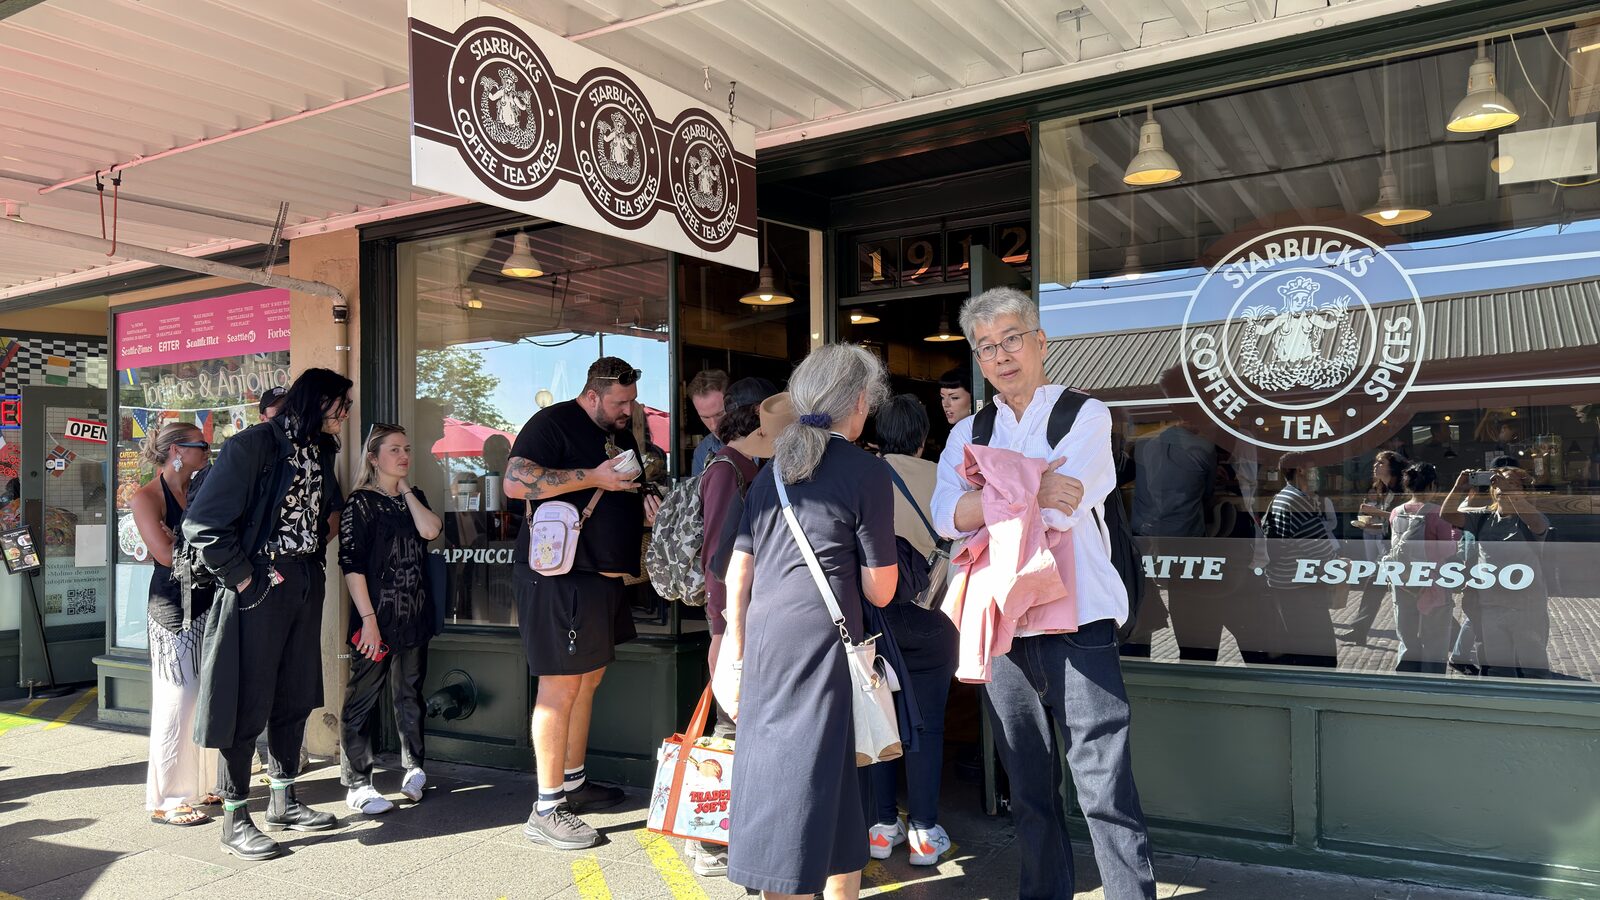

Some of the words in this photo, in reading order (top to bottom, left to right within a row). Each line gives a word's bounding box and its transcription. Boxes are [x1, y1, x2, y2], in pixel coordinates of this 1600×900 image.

[470, 36, 543, 84] STARBUCKS
[588, 85, 646, 126] STARBUCKS
[457, 108, 497, 174] COFFEE
[502, 163, 528, 185] TEA
[527, 139, 557, 182] SPICES
[681, 127, 728, 159] STARBUCKS
[579, 149, 611, 206] COFFEE
[614, 197, 634, 216] TEA
[633, 174, 658, 213] SPICES
[674, 182, 700, 233] COFFEE
[702, 223, 718, 240] TEA
[718, 202, 737, 236] SPICES
[1222, 237, 1375, 290] STARBUCKS
[158, 340, 180, 352] EATER
[267, 328, 290, 339] Forbes
[200, 373, 213, 398] &
[1191, 333, 1248, 421] COFFEE
[1280, 414, 1335, 440] TEA
[1364, 316, 1412, 402] SPICES
[70, 422, 108, 440] OPEN
[431, 548, 516, 564] APPUCCI
[1141, 556, 1226, 580] ATTE
[1291, 558, 1535, 591] ESPRESSO
[694, 801, 728, 814] JOE'S
